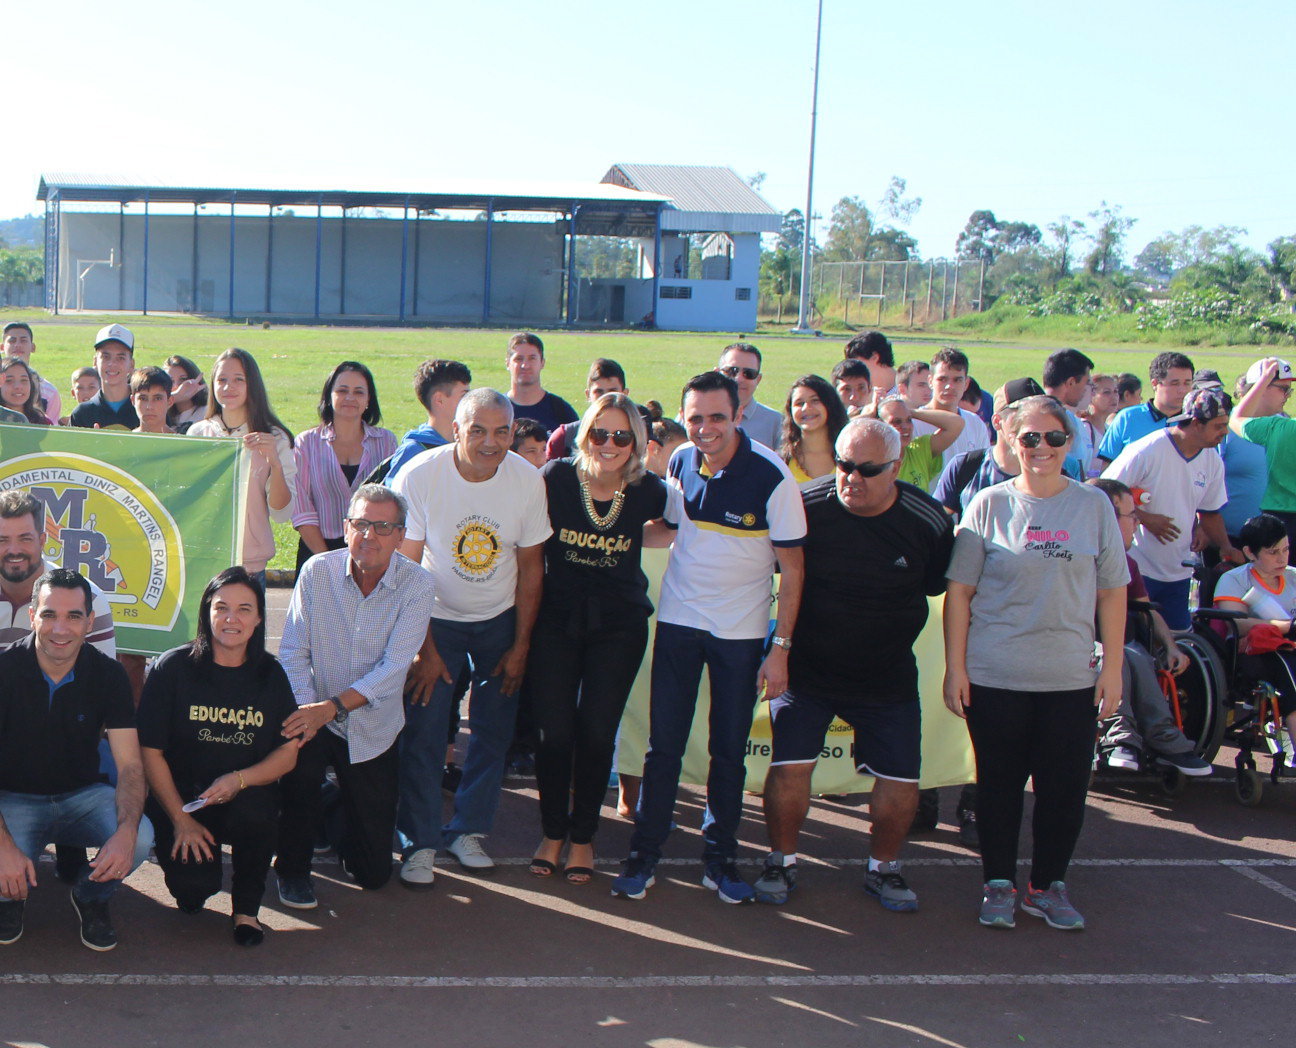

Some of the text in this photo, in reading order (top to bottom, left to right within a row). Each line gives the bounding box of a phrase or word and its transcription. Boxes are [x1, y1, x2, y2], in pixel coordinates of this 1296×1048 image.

[456, 515, 500, 529] ROTARY CLUB
[84, 475, 120, 496] DINIZ
[122, 495, 161, 541] MARTINS
[146, 549, 165, 600] RANGEL
[559, 528, 632, 555] EDUCAÇÃO
[1027, 530, 1070, 542] NILO
[1025, 541, 1061, 551] Carlito
[123, 607, 139, 617] RS
[189, 705, 264, 730] EDUCAÇÃO
